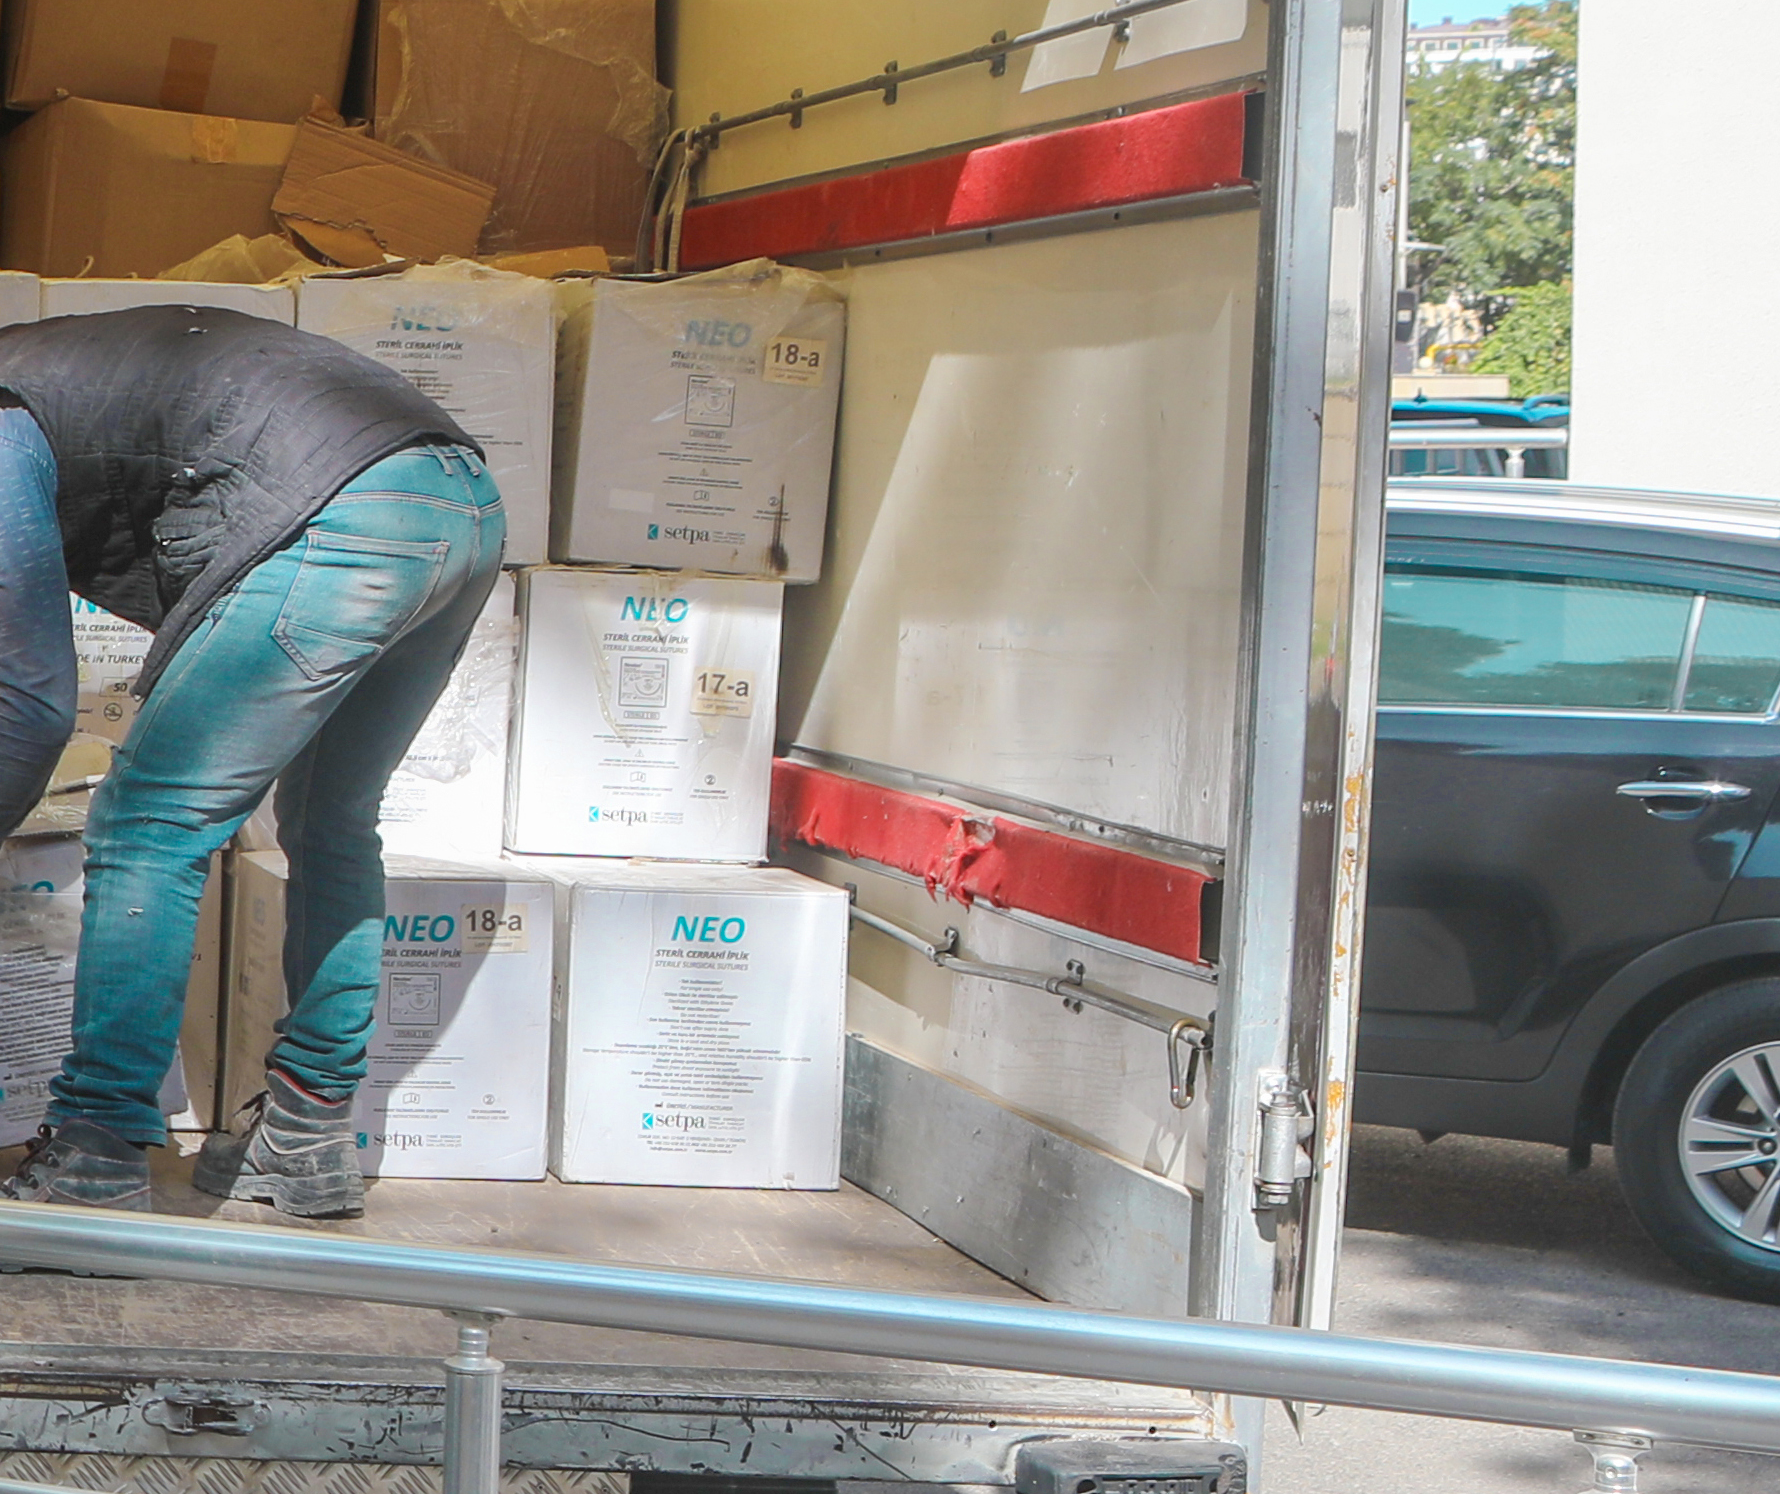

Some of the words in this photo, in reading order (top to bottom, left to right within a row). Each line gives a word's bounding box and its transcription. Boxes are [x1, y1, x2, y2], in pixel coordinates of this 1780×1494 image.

[771, 342, 821, 368] 18-a
[664, 522, 710, 545] setpa
[697, 672, 750, 698] 17-a
[602, 807, 648, 826] setpa
[384, 915, 455, 943] NEO
[466, 909, 523, 932] 18-a
[671, 915, 746, 943] NEO
[655, 949, 684, 958] STERİL
[686, 950, 725, 959] CERRAHİ
[655, 1111, 706, 1132] setpa
[374, 1128, 423, 1150] setpa
